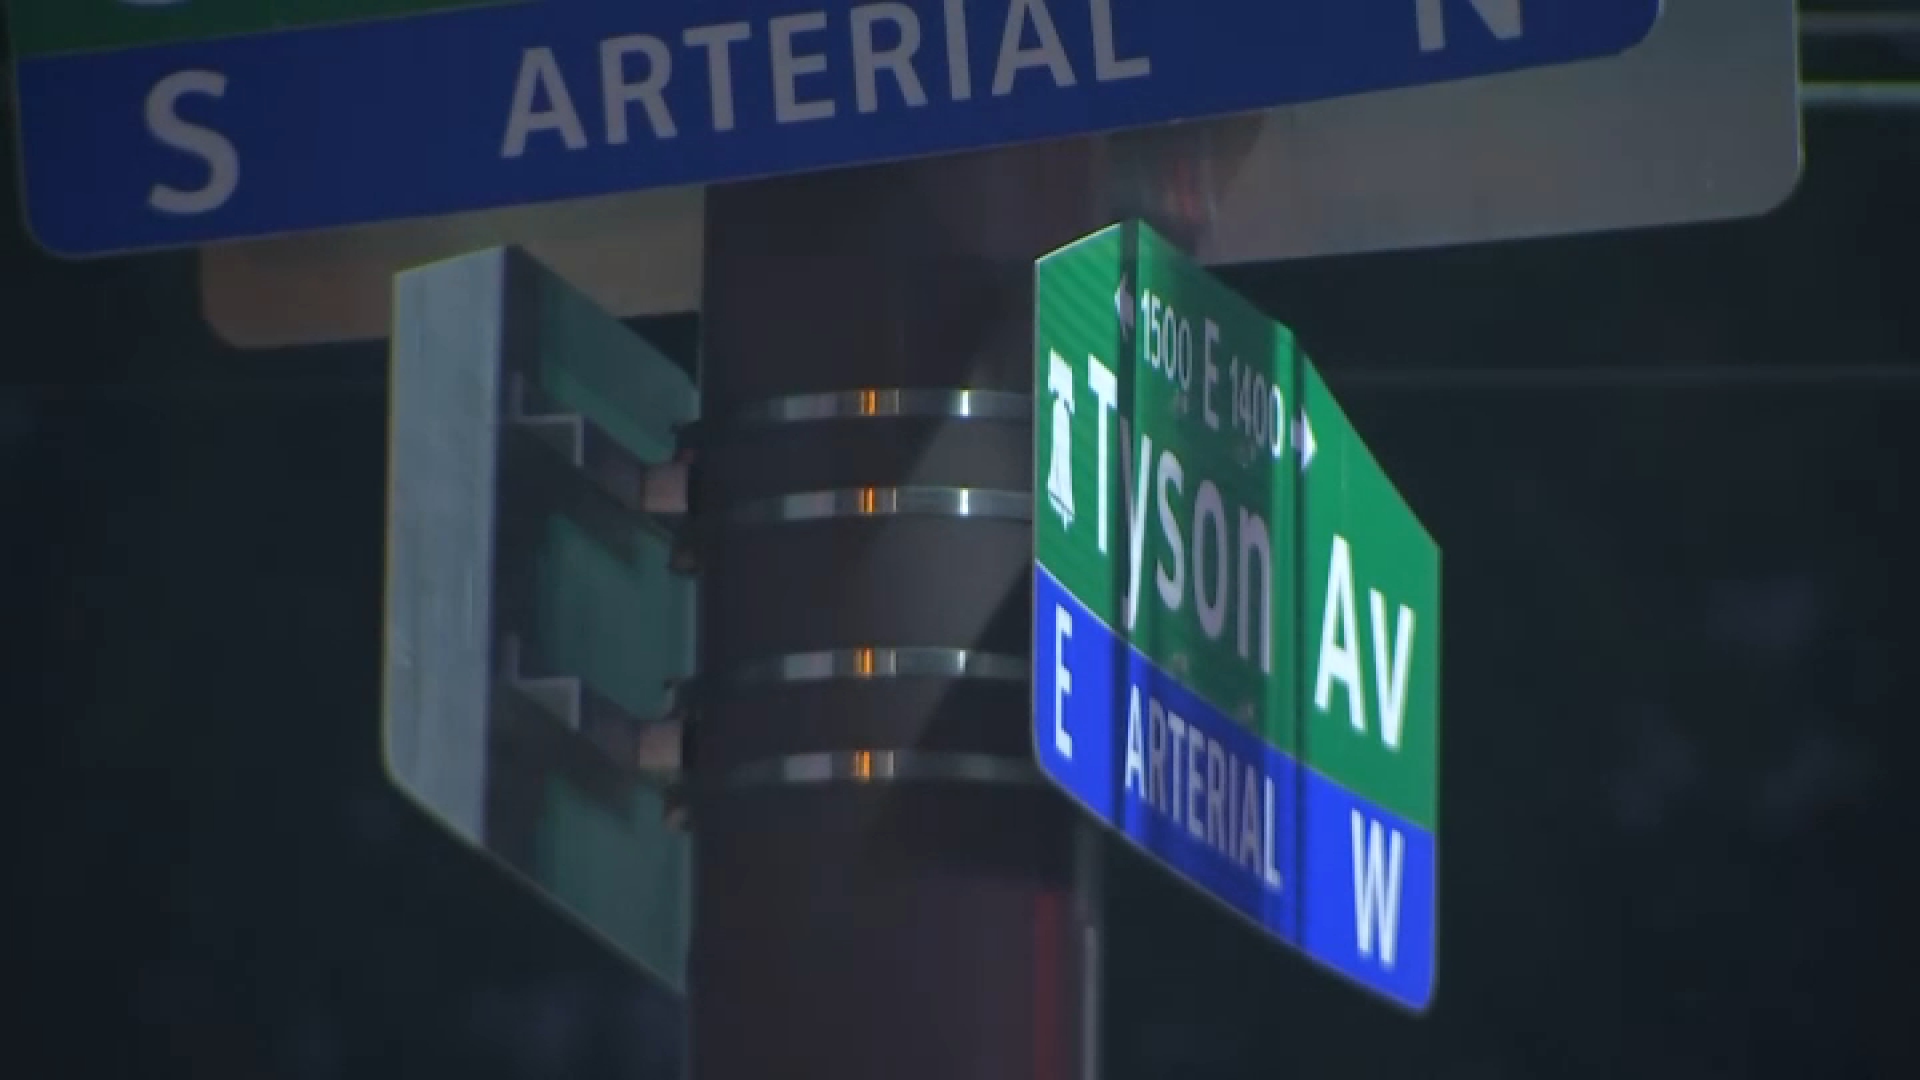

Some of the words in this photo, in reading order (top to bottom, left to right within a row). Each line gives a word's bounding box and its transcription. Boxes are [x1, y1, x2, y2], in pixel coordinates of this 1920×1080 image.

[143, 69, 241, 215] S
[501, 0, 1151, 158] ARTERIAL
[1140, 289, 1193, 391] 1500
[1204, 318, 1220, 431] E
[1229, 356, 1285, 459] 1400
[1087, 353, 1272, 674] Tyson
[1314, 534, 1415, 751] Av
[1055, 603, 1073, 759] E
[1125, 684, 1282, 889] ARTERIAL
[1351, 808, 1404, 968] W
